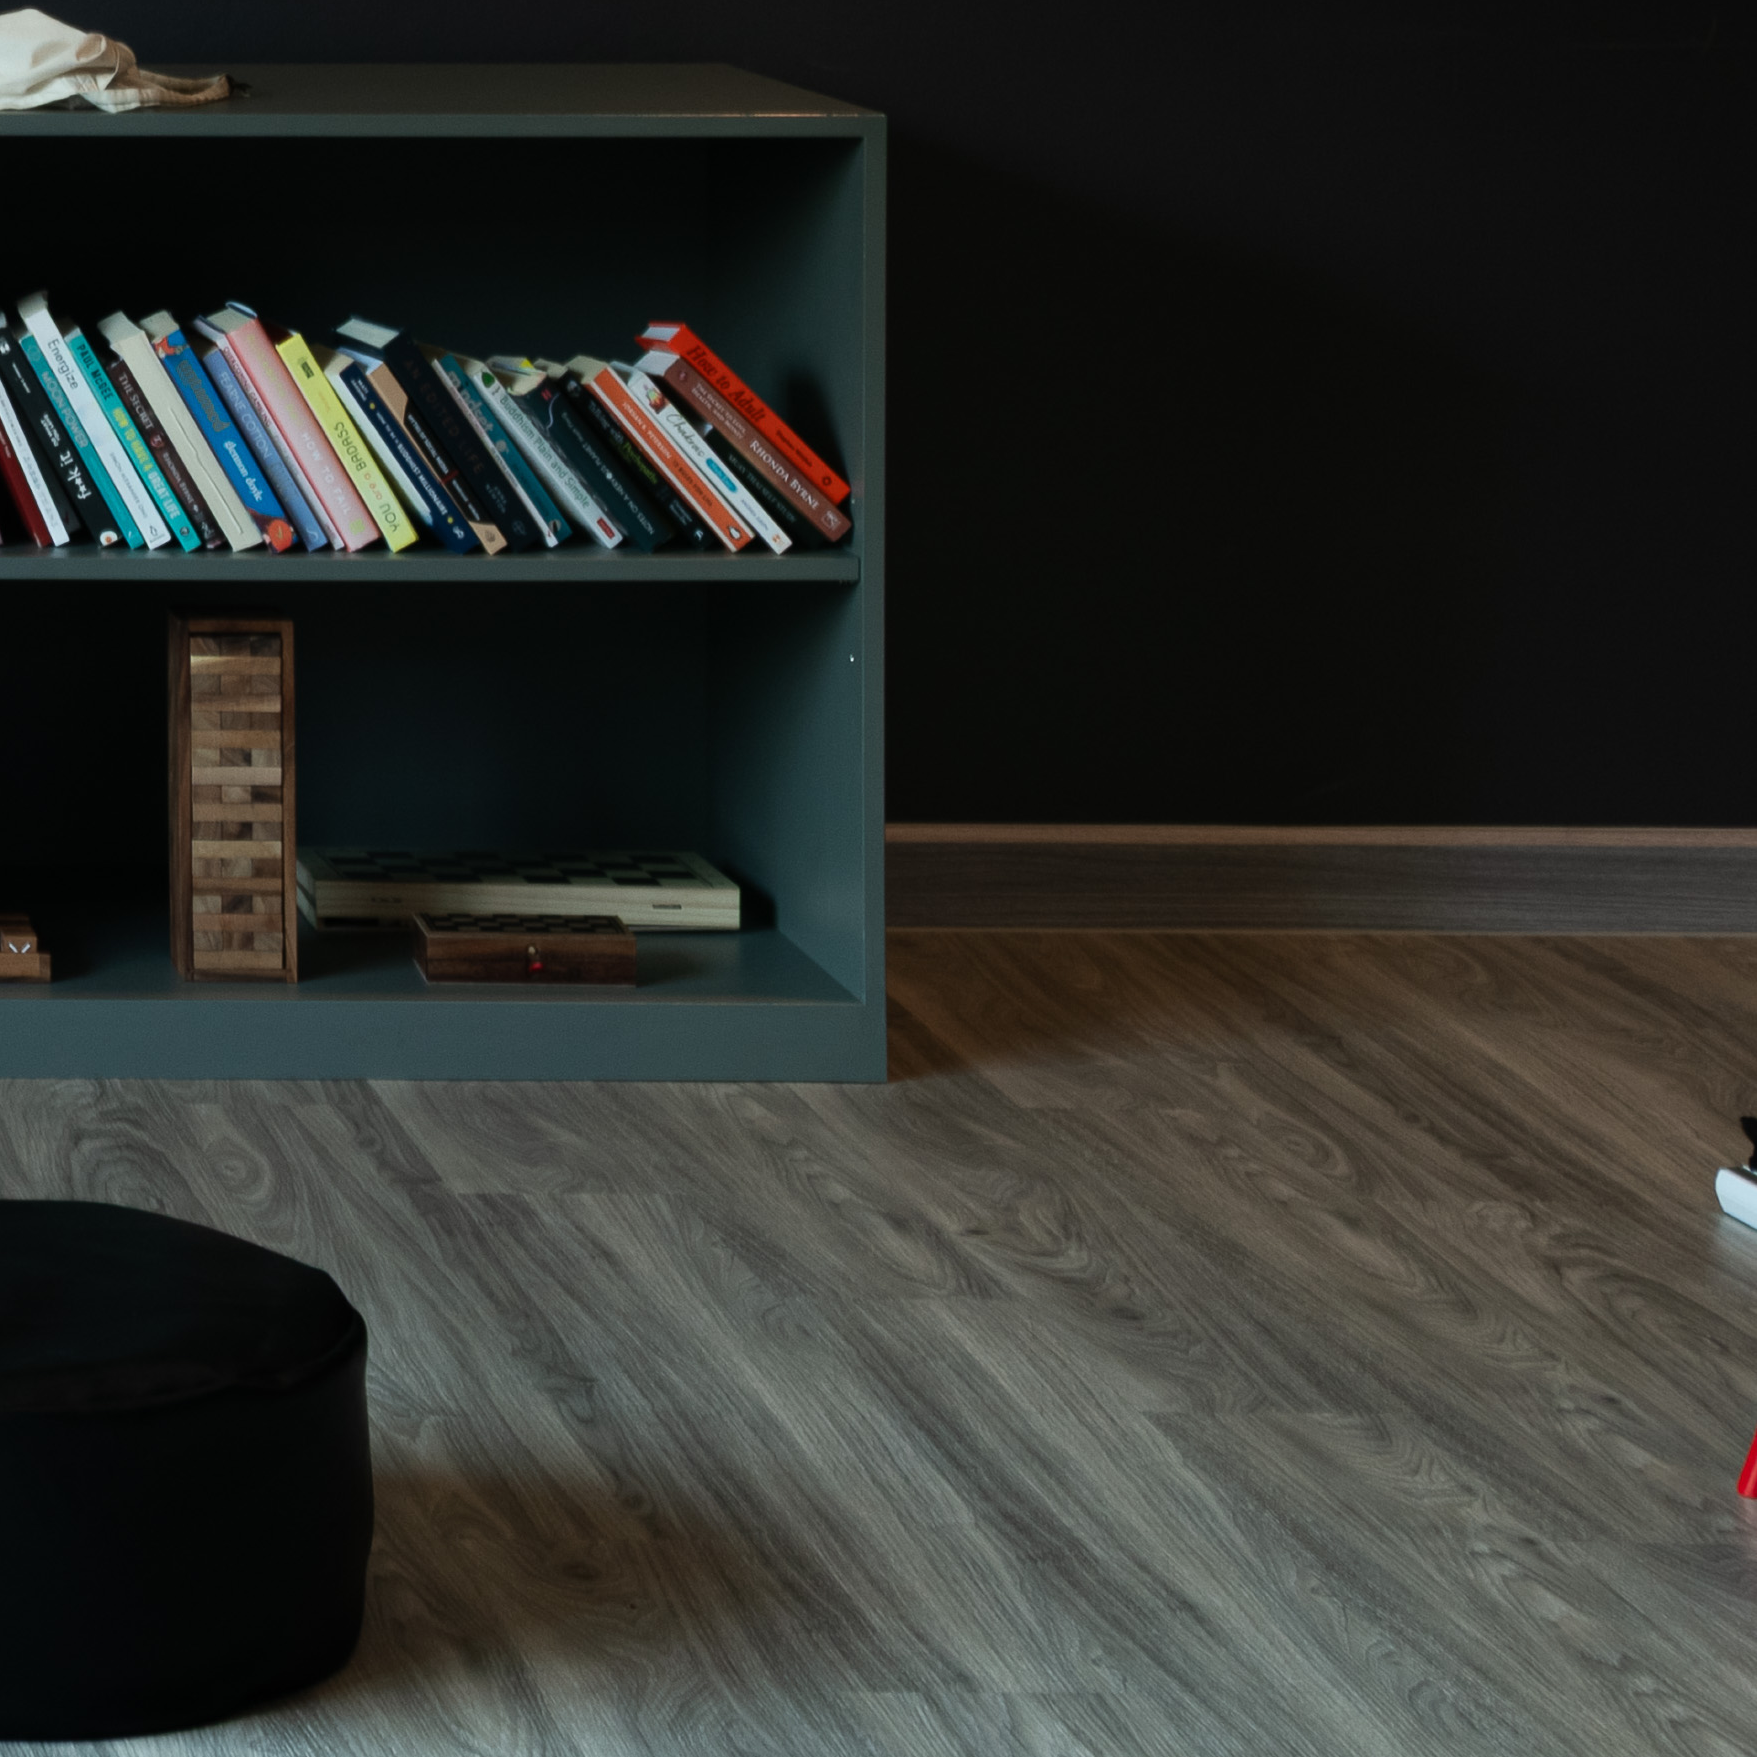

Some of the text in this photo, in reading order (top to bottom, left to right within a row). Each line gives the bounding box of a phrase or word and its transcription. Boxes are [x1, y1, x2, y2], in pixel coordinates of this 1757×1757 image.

[47, 338, 78, 389] Energize
[76, 343, 113, 400] PAUL McGEE
[222, 348, 272, 428] OVERCOMING GAMBLING
[685, 345, 769, 422] How to Adult
[41, 370, 88, 448] MOON POWER
[118, 372, 153, 429] THE SECRET
[219, 370, 272, 461] FEARNE COTTON
[403, 359, 420, 380] AN
[419, 382, 460, 437] EDITED
[458, 441, 485, 474] LIFE
[665, 412, 704, 456] Chakras
[113, 407, 180, 519] HOW TO HAVE A GREAT LIFE
[300, 432, 353, 515] HOW TO FAIL
[333, 421, 400, 532] YOU are a BADASS
[499, 393, 534, 438] Buddhism
[533, 436, 552, 461] Plain
[549, 460, 569, 479] and
[563, 475, 590, 508] Simple
[581, 442, 601, 465] PLANET
[749, 439, 819, 509] RHONDA BYRNE
[244, 476, 263, 502] doyle
[622, 492, 630, 501] A
[627, 499, 639, 513] ON
[636, 511, 654, 534] NOTES
